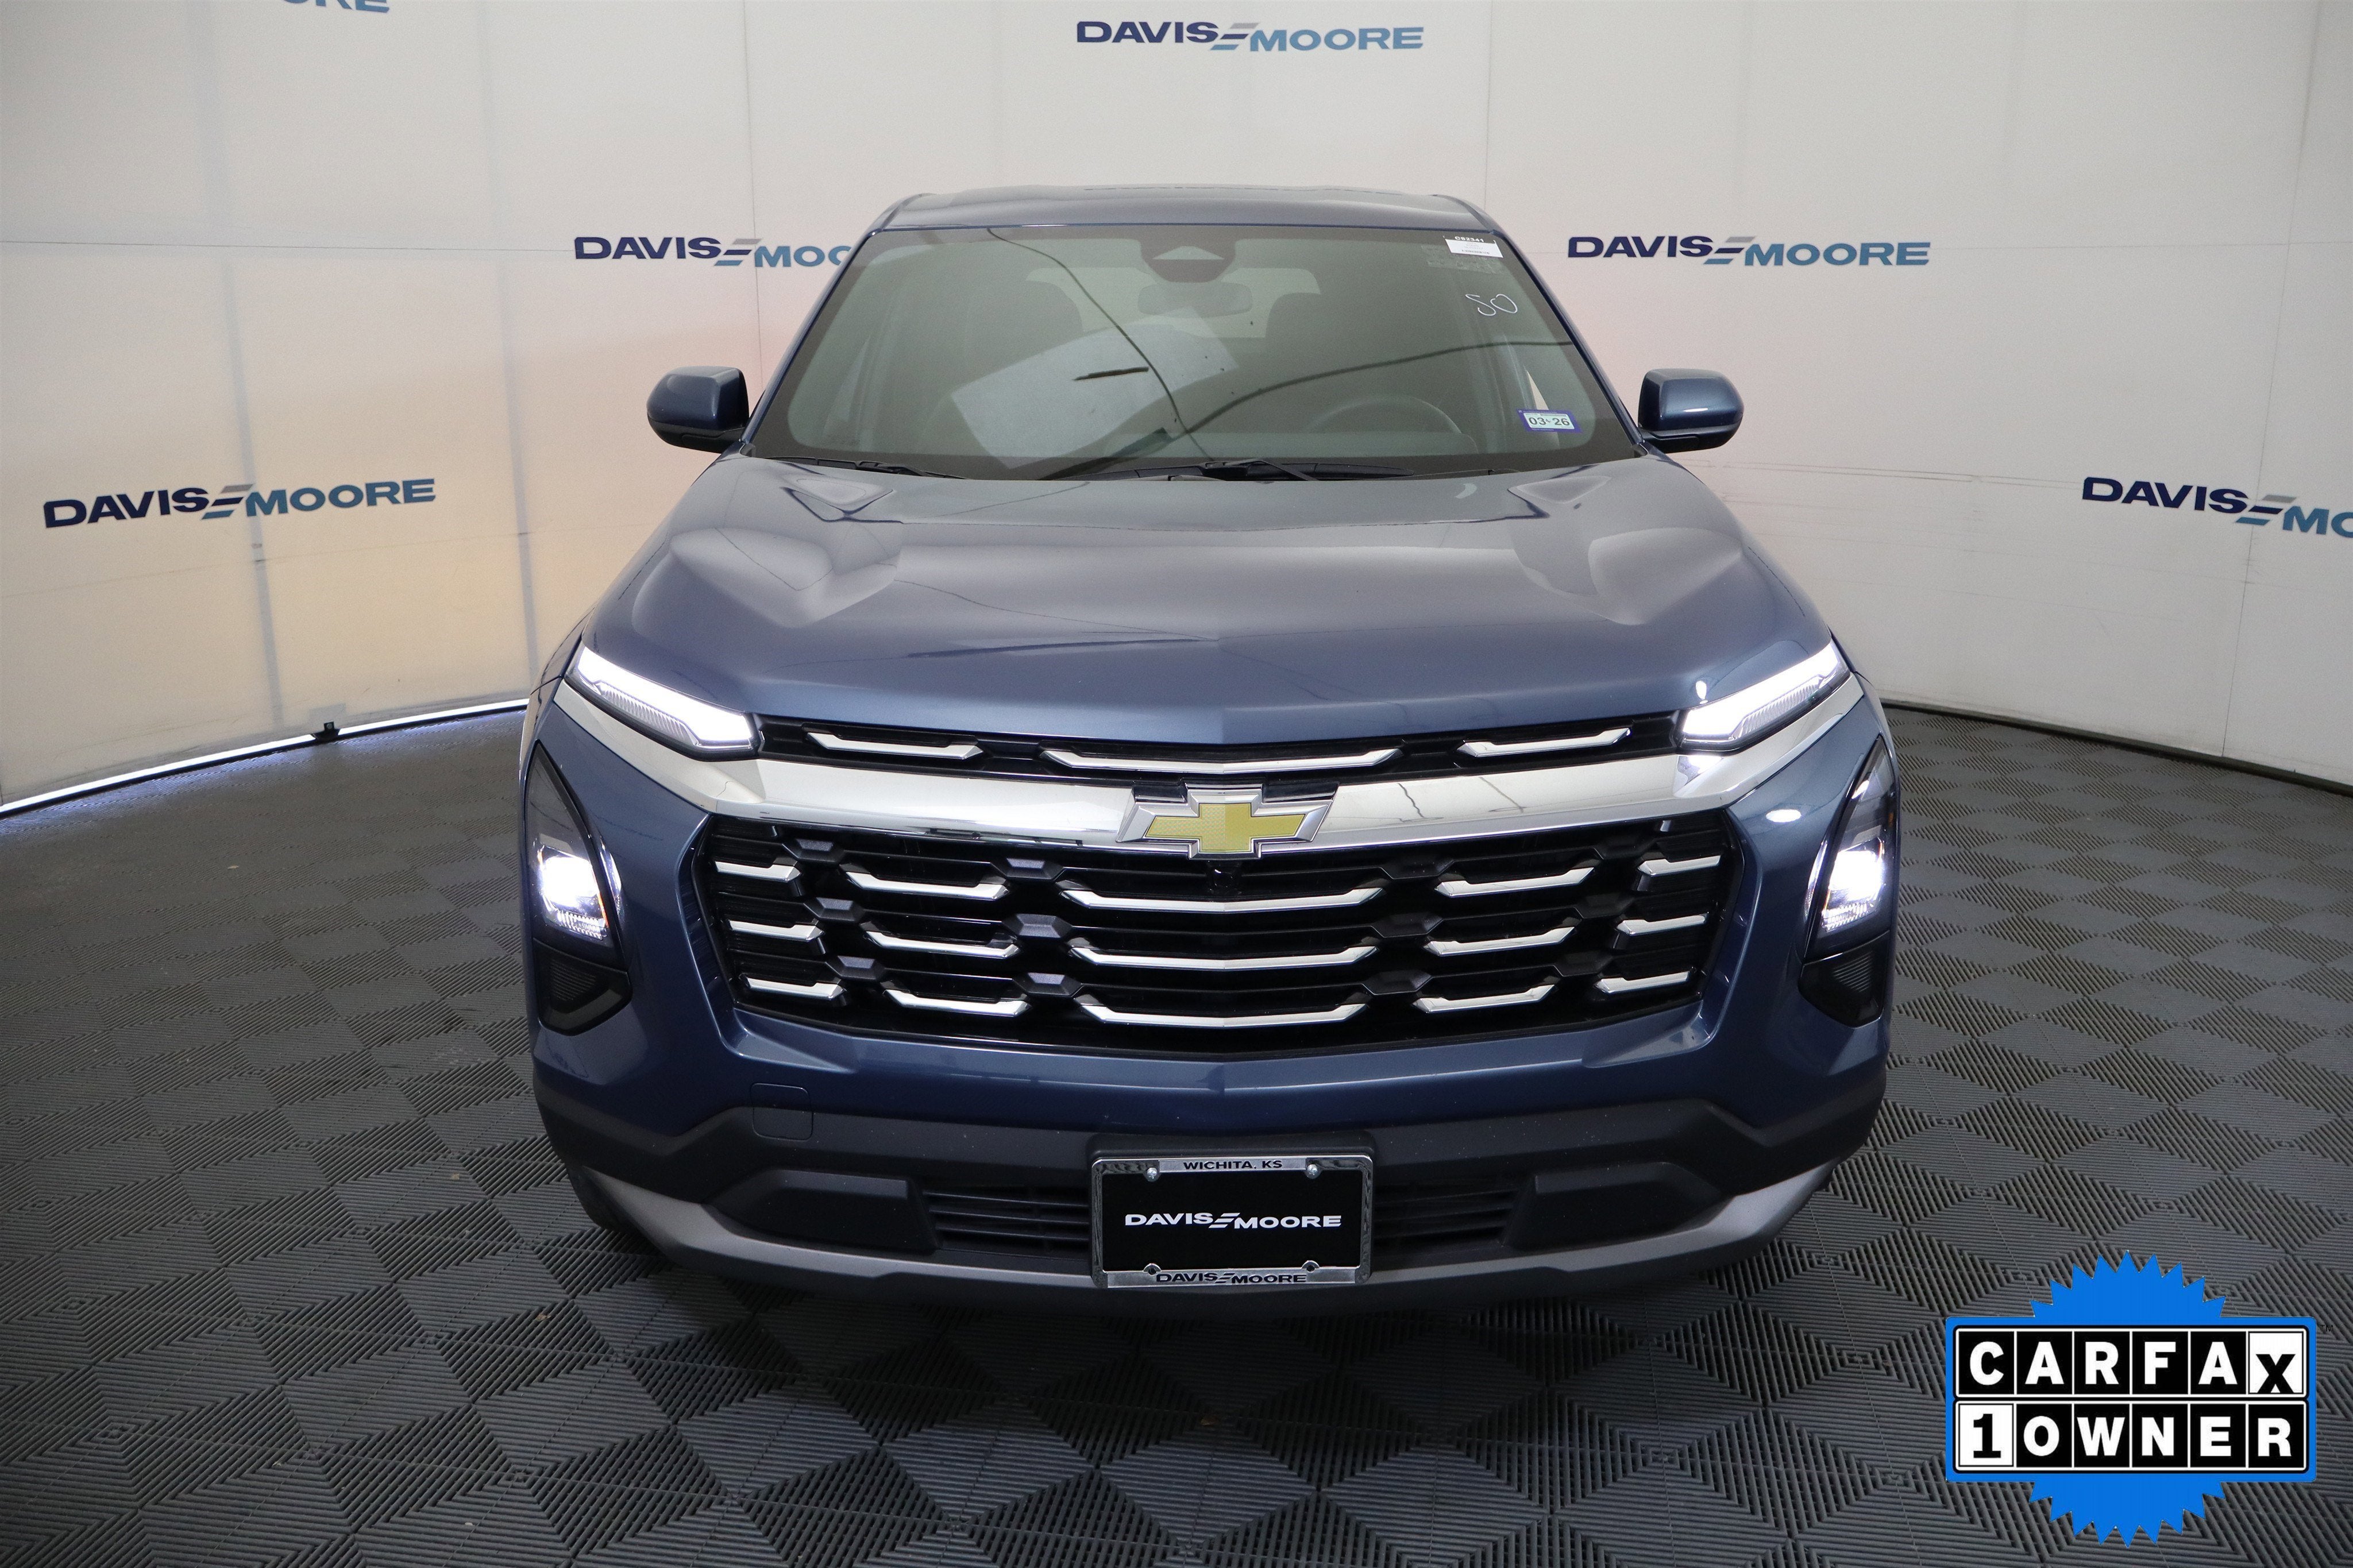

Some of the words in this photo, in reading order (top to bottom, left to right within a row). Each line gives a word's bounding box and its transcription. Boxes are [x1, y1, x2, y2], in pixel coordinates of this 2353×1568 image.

[1077, 21, 1218, 43] DAVIS
[1250, 27, 1424, 52] MOORE
[574, 237, 722, 259] DAVIS
[754, 245, 852, 267] MOO
[1568, 236, 1713, 257] DAVIS
[1745, 242, 1931, 266] MOORE
[43, 488, 208, 528] DAVIS
[245, 478, 435, 517] MOORE
[2082, 477, 2248, 513] DAVIS
[1262, 1160, 1282, 1168] KS
[1125, 1212, 1213, 1226] DAVIS
[1234, 1215, 1341, 1229] MOORE
[1156, 1273, 1217, 1283] DAVIS
[1231, 1275, 1307, 1283] MOORE
